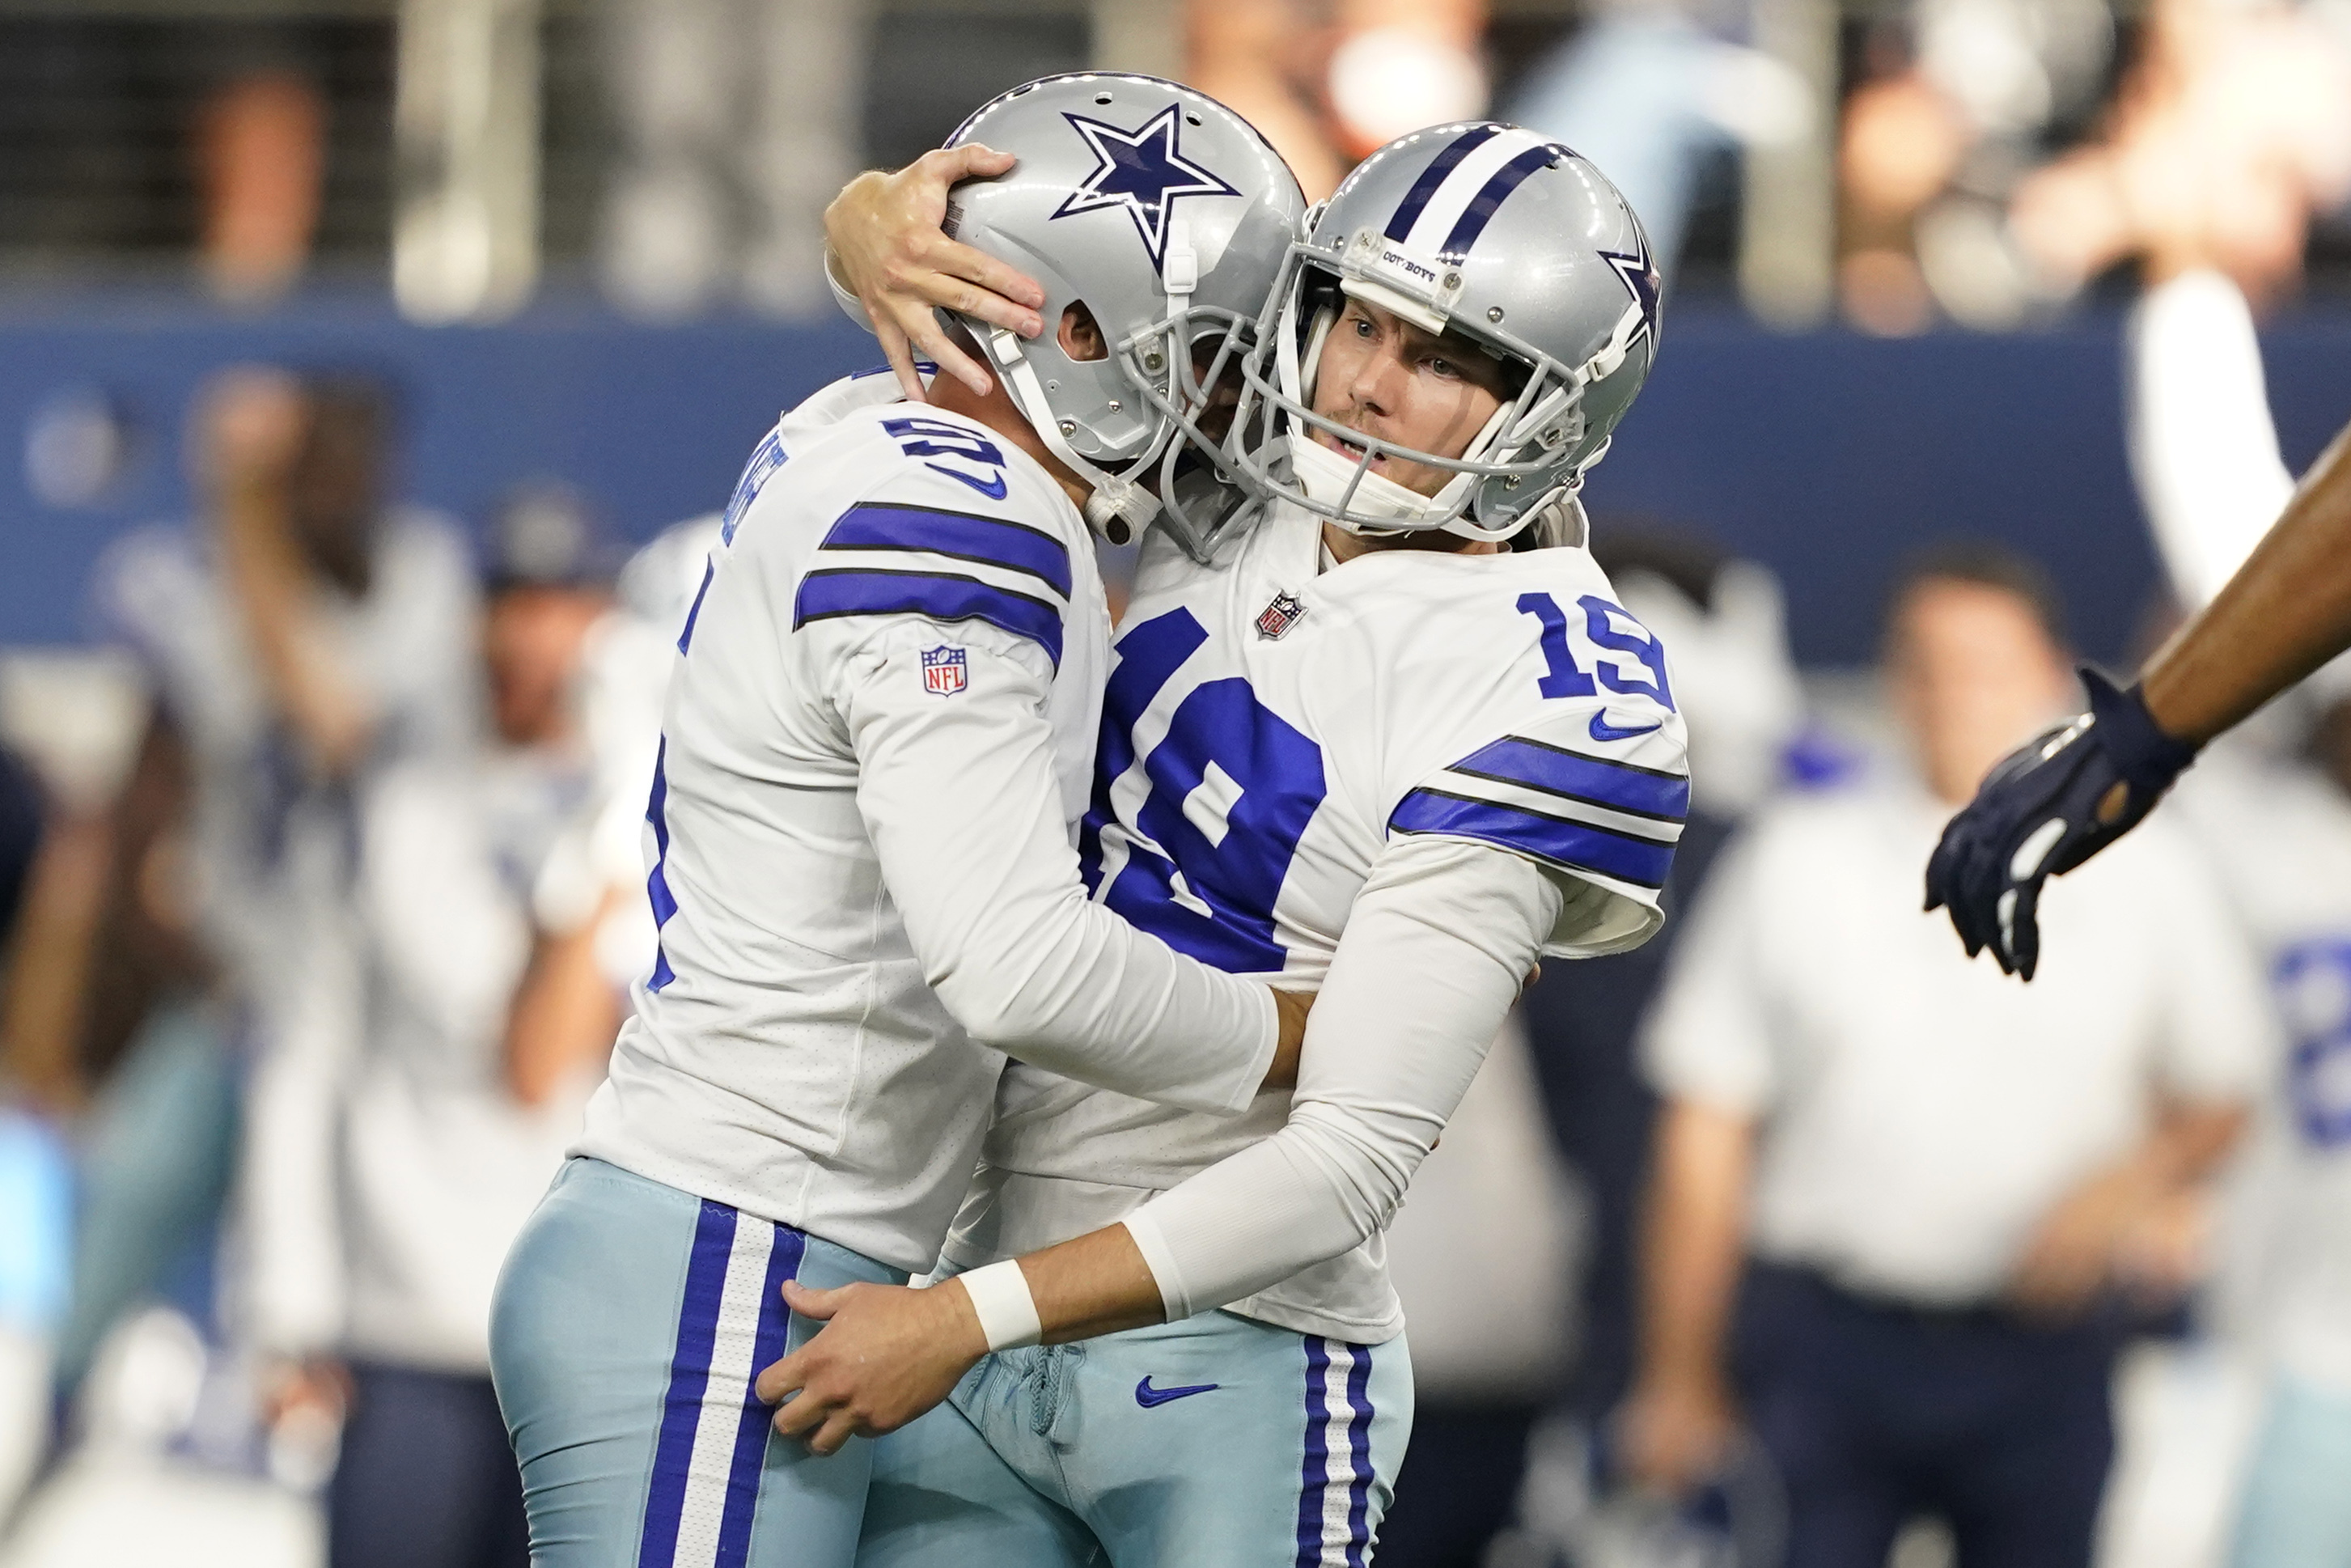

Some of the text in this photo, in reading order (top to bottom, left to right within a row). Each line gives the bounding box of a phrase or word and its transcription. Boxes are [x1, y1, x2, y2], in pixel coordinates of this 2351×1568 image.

[1383, 251, 1436, 282] COWBOYS
[878, 417, 1007, 469] 5
[1260, 607, 1286, 634] NFL
[1515, 592, 1676, 714] 19
[927, 667, 964, 690] NFL
[1078, 605, 1328, 974] 19
